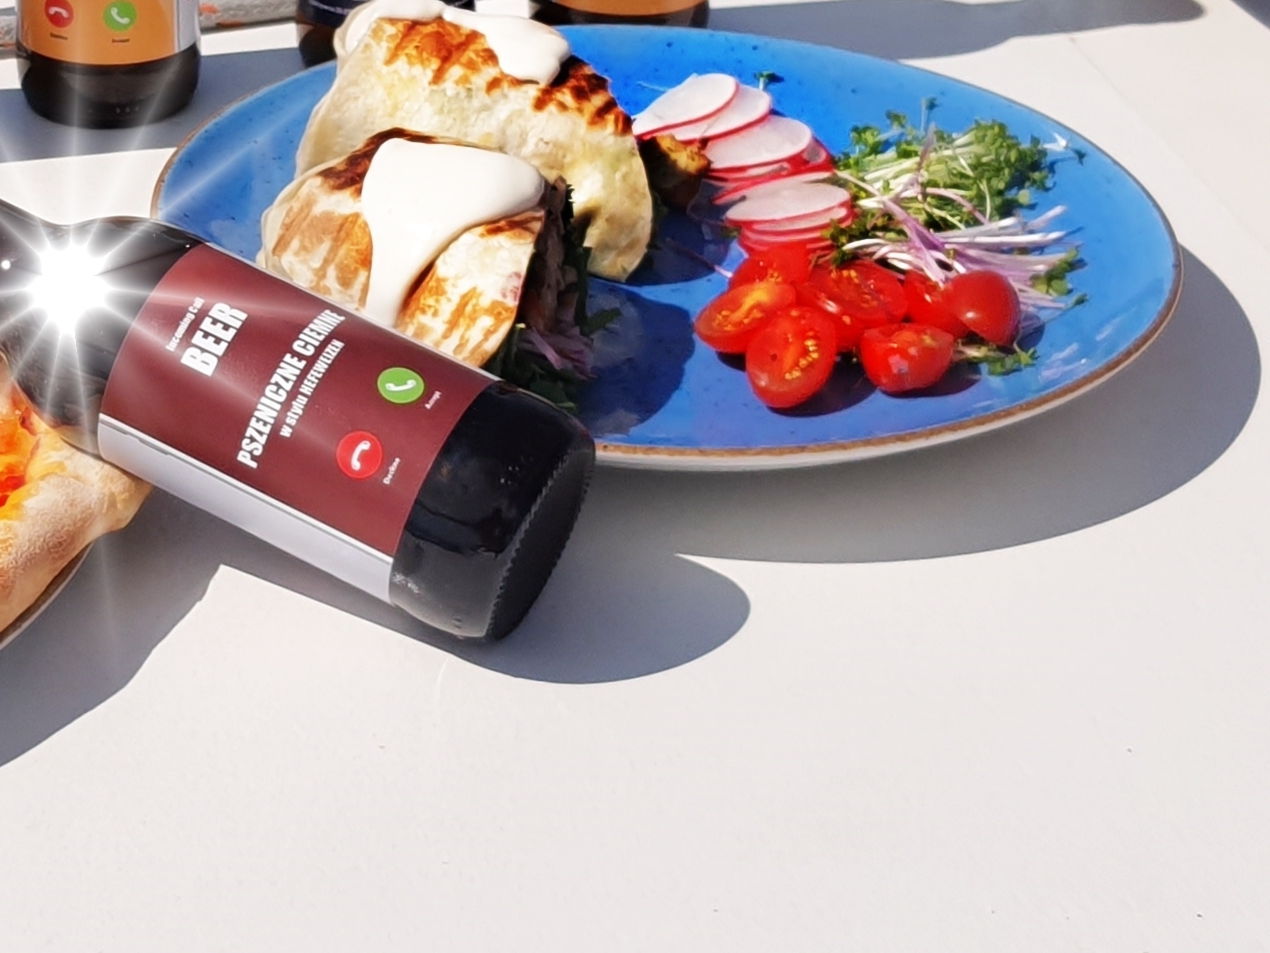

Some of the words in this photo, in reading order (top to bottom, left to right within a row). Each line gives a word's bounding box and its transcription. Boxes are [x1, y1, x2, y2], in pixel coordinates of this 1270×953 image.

[165, 312, 196, 353] Incoming
[188, 296, 205, 314] Call
[180, 302, 248, 377] BEER
[236, 352, 308, 469] PSZENICZNE
[292, 309, 346, 357] CIEMNE
[299, 338, 346, 396] HEFEWEIZEN
[279, 424, 293, 438] w
[285, 394, 309, 426] stylu
